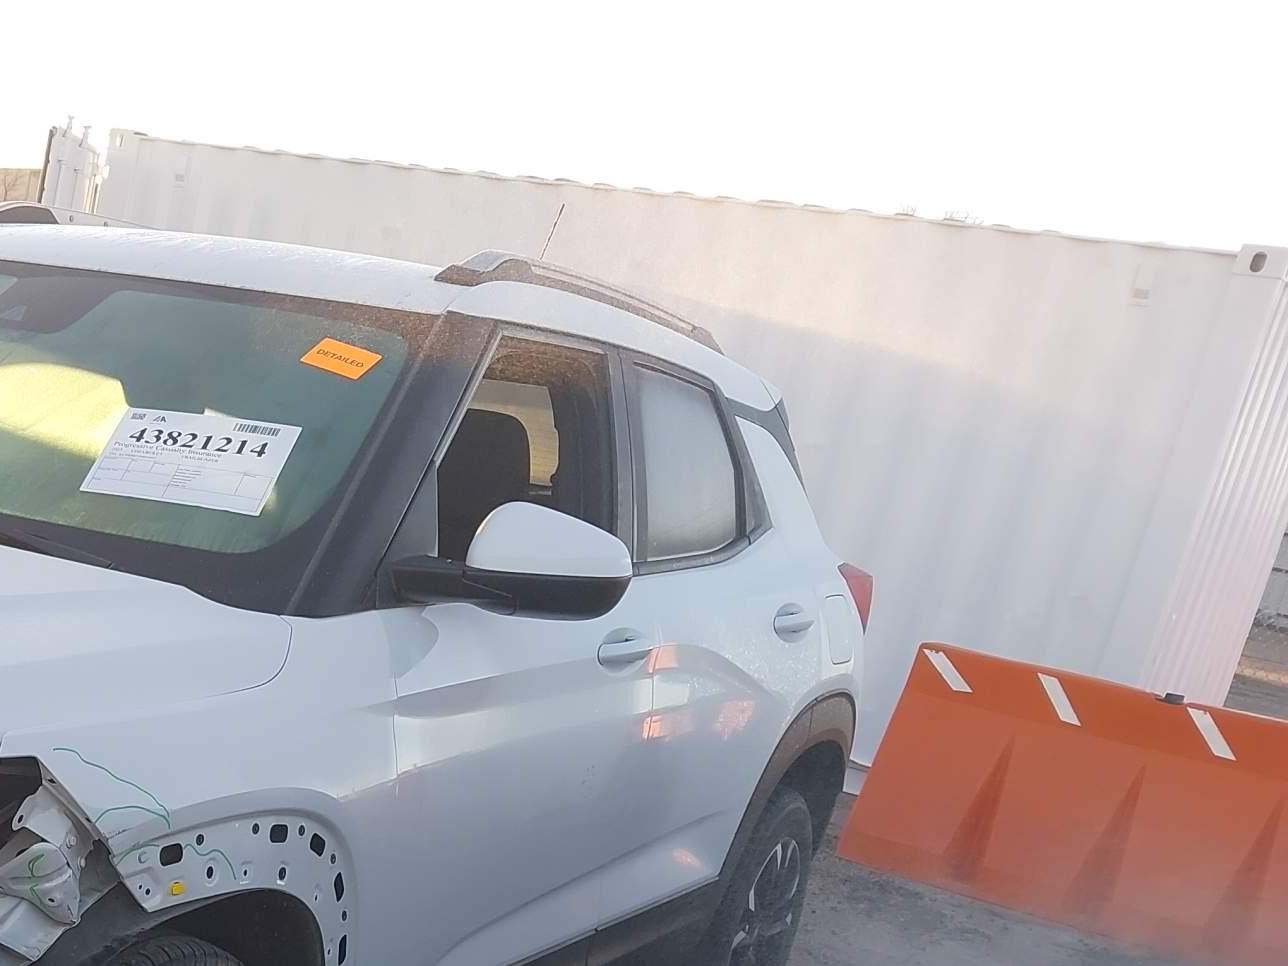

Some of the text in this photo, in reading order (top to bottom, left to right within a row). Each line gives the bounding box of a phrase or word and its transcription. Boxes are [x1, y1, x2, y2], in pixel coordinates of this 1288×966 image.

[316, 348, 364, 368] DETAILED
[114, 441, 154, 451] Progressive
[155, 445, 186, 455] Casualty
[188, 449, 223, 458] Insurance
[129, 427, 269, 458] 43821214
